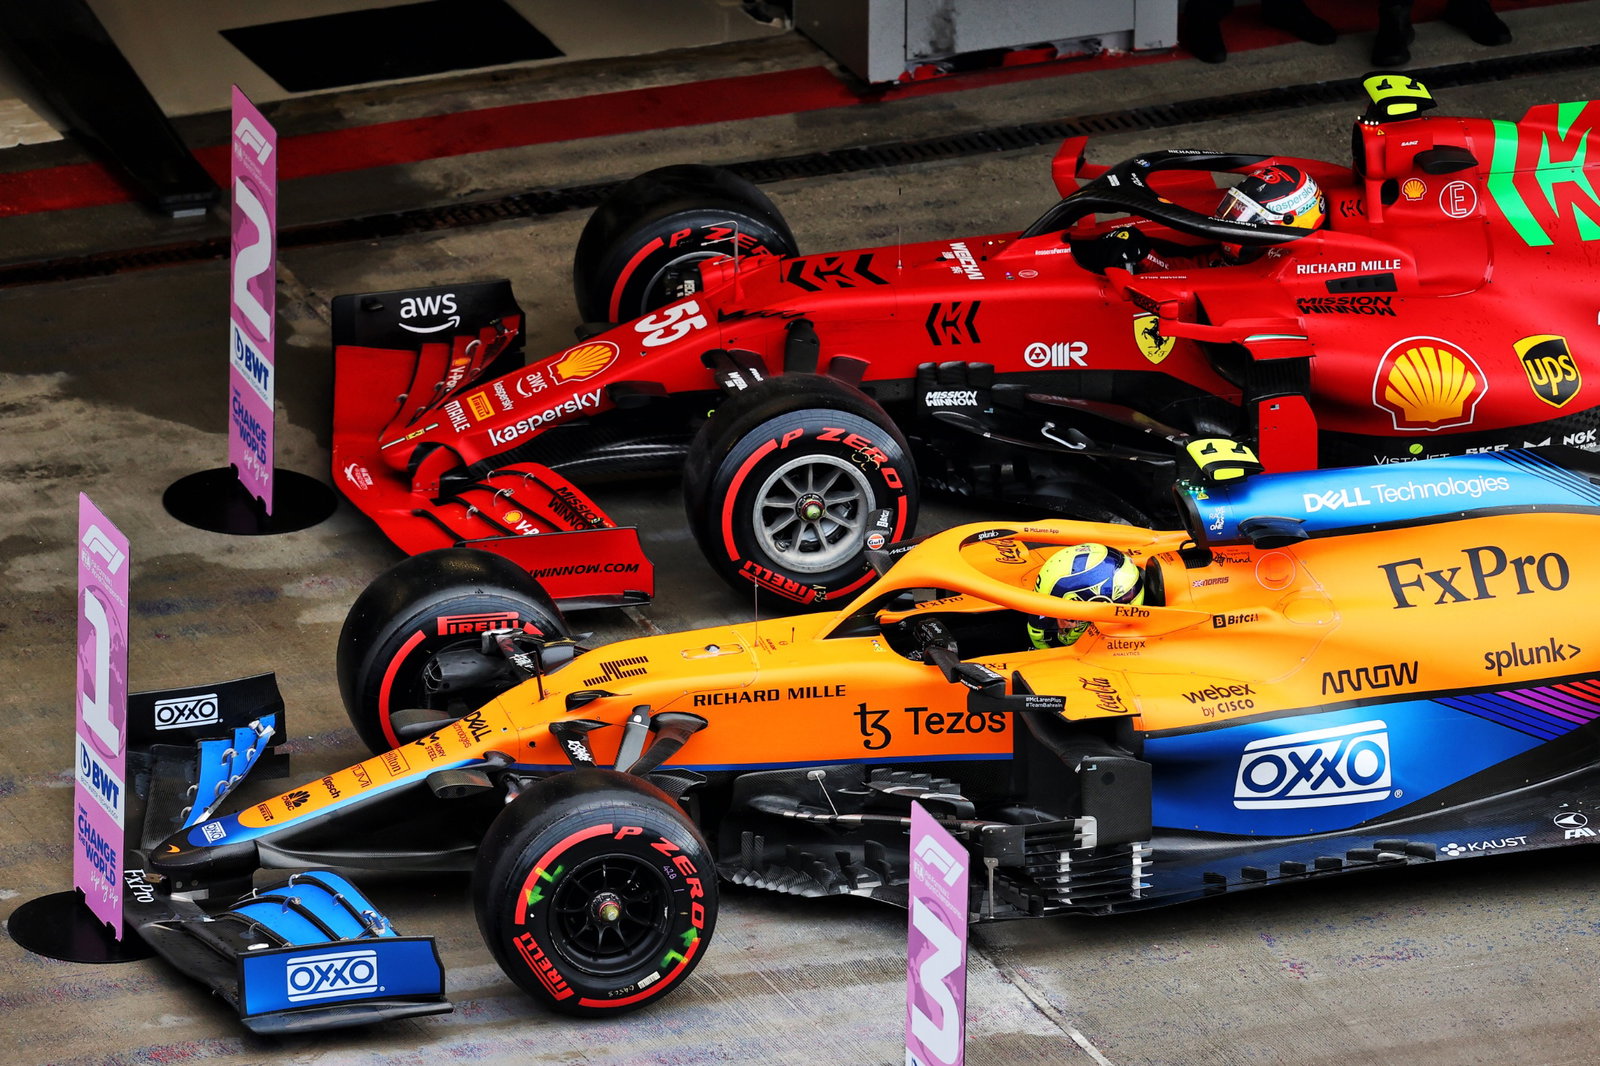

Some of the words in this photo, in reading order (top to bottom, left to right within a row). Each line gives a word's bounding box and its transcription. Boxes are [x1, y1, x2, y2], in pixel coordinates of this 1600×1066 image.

[1268, 185, 1314, 212] kaspersky
[669, 228, 692, 249] P
[704, 226, 775, 259] ZER
[235, 176, 272, 342] 2
[1297, 261, 1357, 275] RICHARD
[1360, 259, 1401, 272] MILLE
[400, 293, 457, 320] aws
[1296, 296, 1392, 306] MISSION
[1300, 304, 1397, 316] WINNOW
[634, 300, 708, 347] 55
[244, 344, 270, 391] BWT
[526, 372, 548, 393] aws
[1525, 353, 1578, 396] ups
[471, 394, 491, 418] PIRELLI
[493, 380, 514, 411] kaspersky
[925, 399, 978, 407] WINNOW
[926, 390, 978, 400] MISSION
[232, 397, 267, 448] CHANGE
[444, 400, 471, 433] MAHLE
[487, 388, 603, 446] kaspersky
[238, 425, 267, 464] WORLD
[1563, 428, 1597, 446] NGK
[780, 428, 804, 449] P
[816, 427, 904, 489] ZERO
[557, 486, 603, 525] MISSIO
[1303, 488, 1371, 514] DELL
[1371, 474, 1510, 505] Technologies
[548, 497, 590, 532] WINNO
[868, 538, 884, 546] Gulf
[978, 530, 999, 540] splunk>
[1226, 553, 1252, 564] mind
[738, 560, 815, 604] PIRELLI
[1202, 576, 1230, 587] NORRIS
[1377, 546, 1570, 611] FxPro
[437, 612, 520, 636] PIRELLI
[1114, 606, 1150, 618] FxPro
[1107, 639, 1146, 651] alteryx
[1484, 637, 1581, 678] splunk>
[82, 587, 119, 758] 1
[1322, 660, 1419, 695] ARROW
[694, 689, 780, 707] RICHARD
[787, 685, 847, 701] MILLE
[1182, 683, 1257, 704] webex
[156, 699, 217, 725] OXXO
[464, 711, 492, 743] DELL
[905, 707, 1006, 735] Tezos
[1202, 706, 1215, 718] by
[451, 720, 472, 749] echnologies
[384, 752, 402, 773] Hilton
[1242, 736, 1386, 795] OXXO
[92, 760, 119, 810] BWT
[258, 804, 275, 822] PIRELLI
[281, 795, 295, 811] CNBC
[78, 814, 117, 870] CHANGE
[203, 822, 225, 842] OXXO
[1467, 836, 1527, 852] KAUST
[85, 840, 116, 887] WORLD
[614, 826, 644, 840] P
[651, 837, 705, 929] ZERO
[124, 868, 154, 903] FxPro
[288, 956, 375, 995] OXXO
[513, 932, 575, 1001] PIRELLI
[912, 895, 962, 1065] 3
